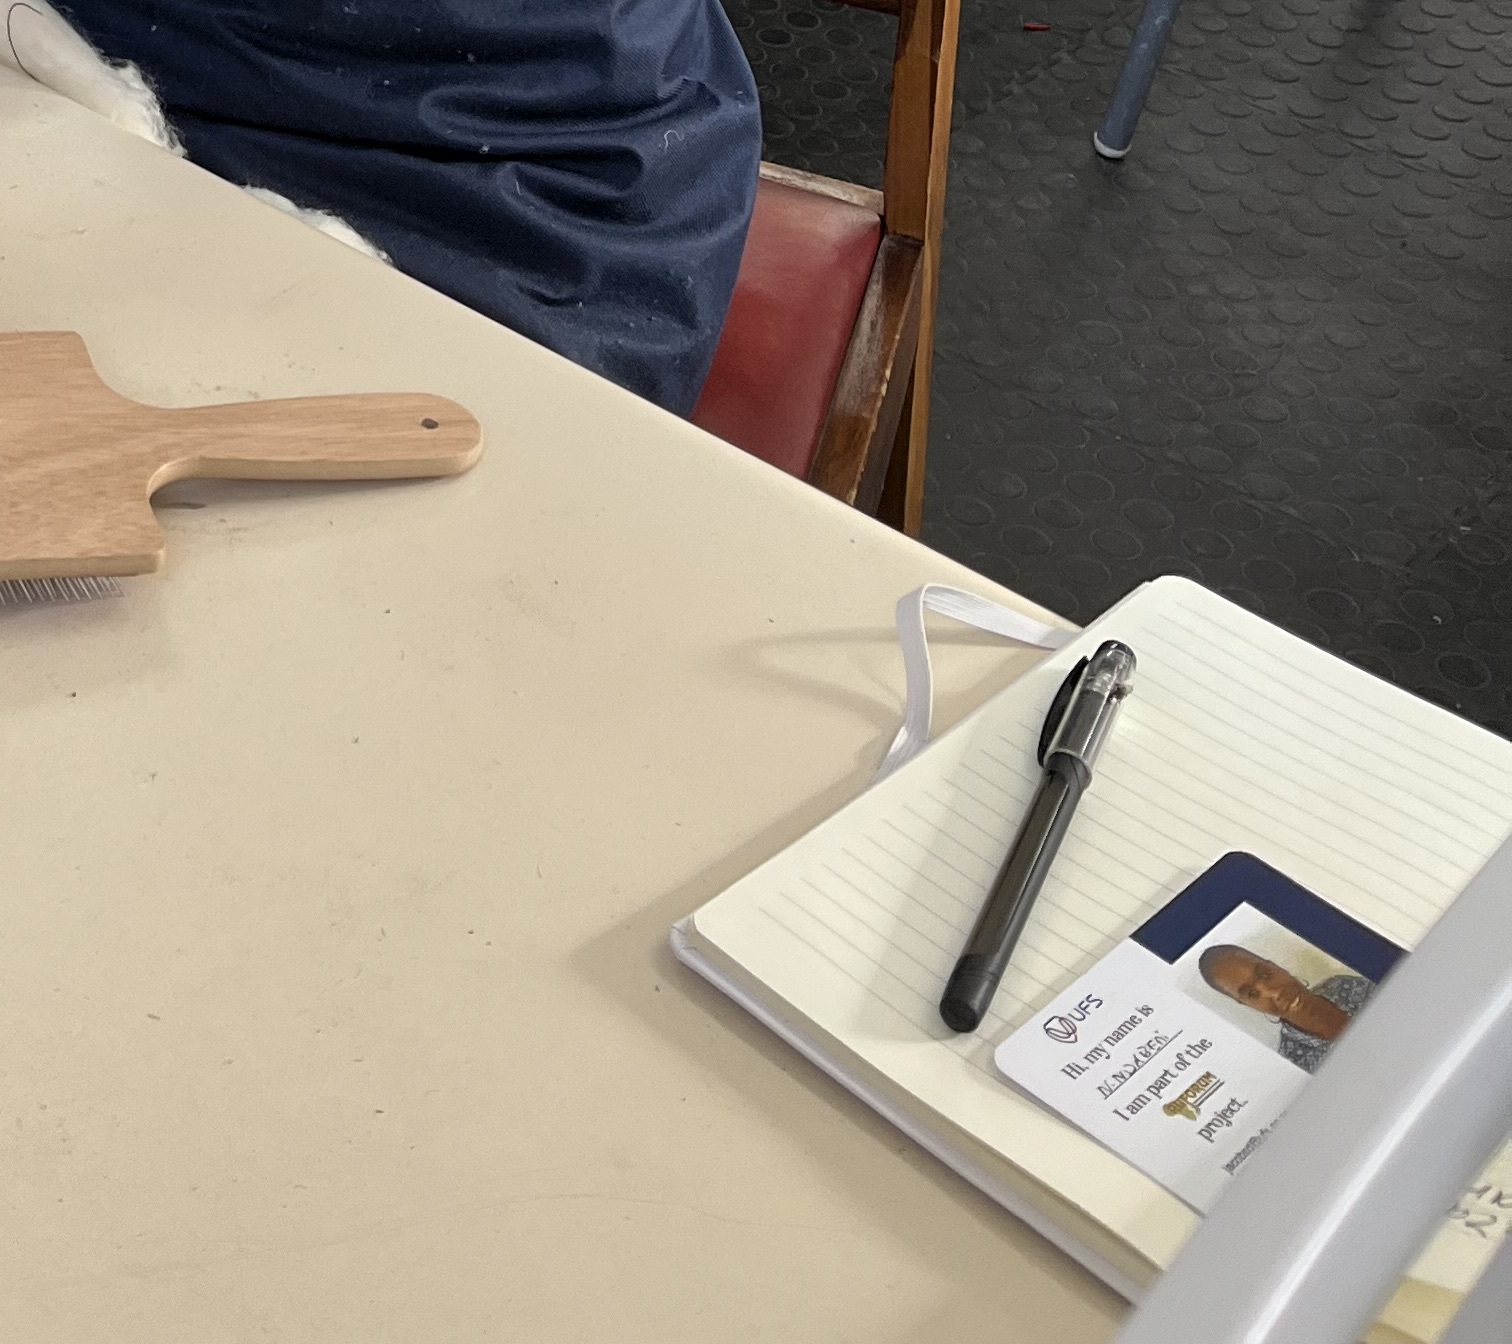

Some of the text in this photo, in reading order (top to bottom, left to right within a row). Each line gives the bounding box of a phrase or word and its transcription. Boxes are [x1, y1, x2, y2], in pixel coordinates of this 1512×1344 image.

[1068, 994, 1103, 1022] UFS
[1060, 1004, 1155, 1080] Hi, my name is
[1112, 1038, 1213, 1122] I am part of the
[1196, 1097, 1249, 1144] project.
